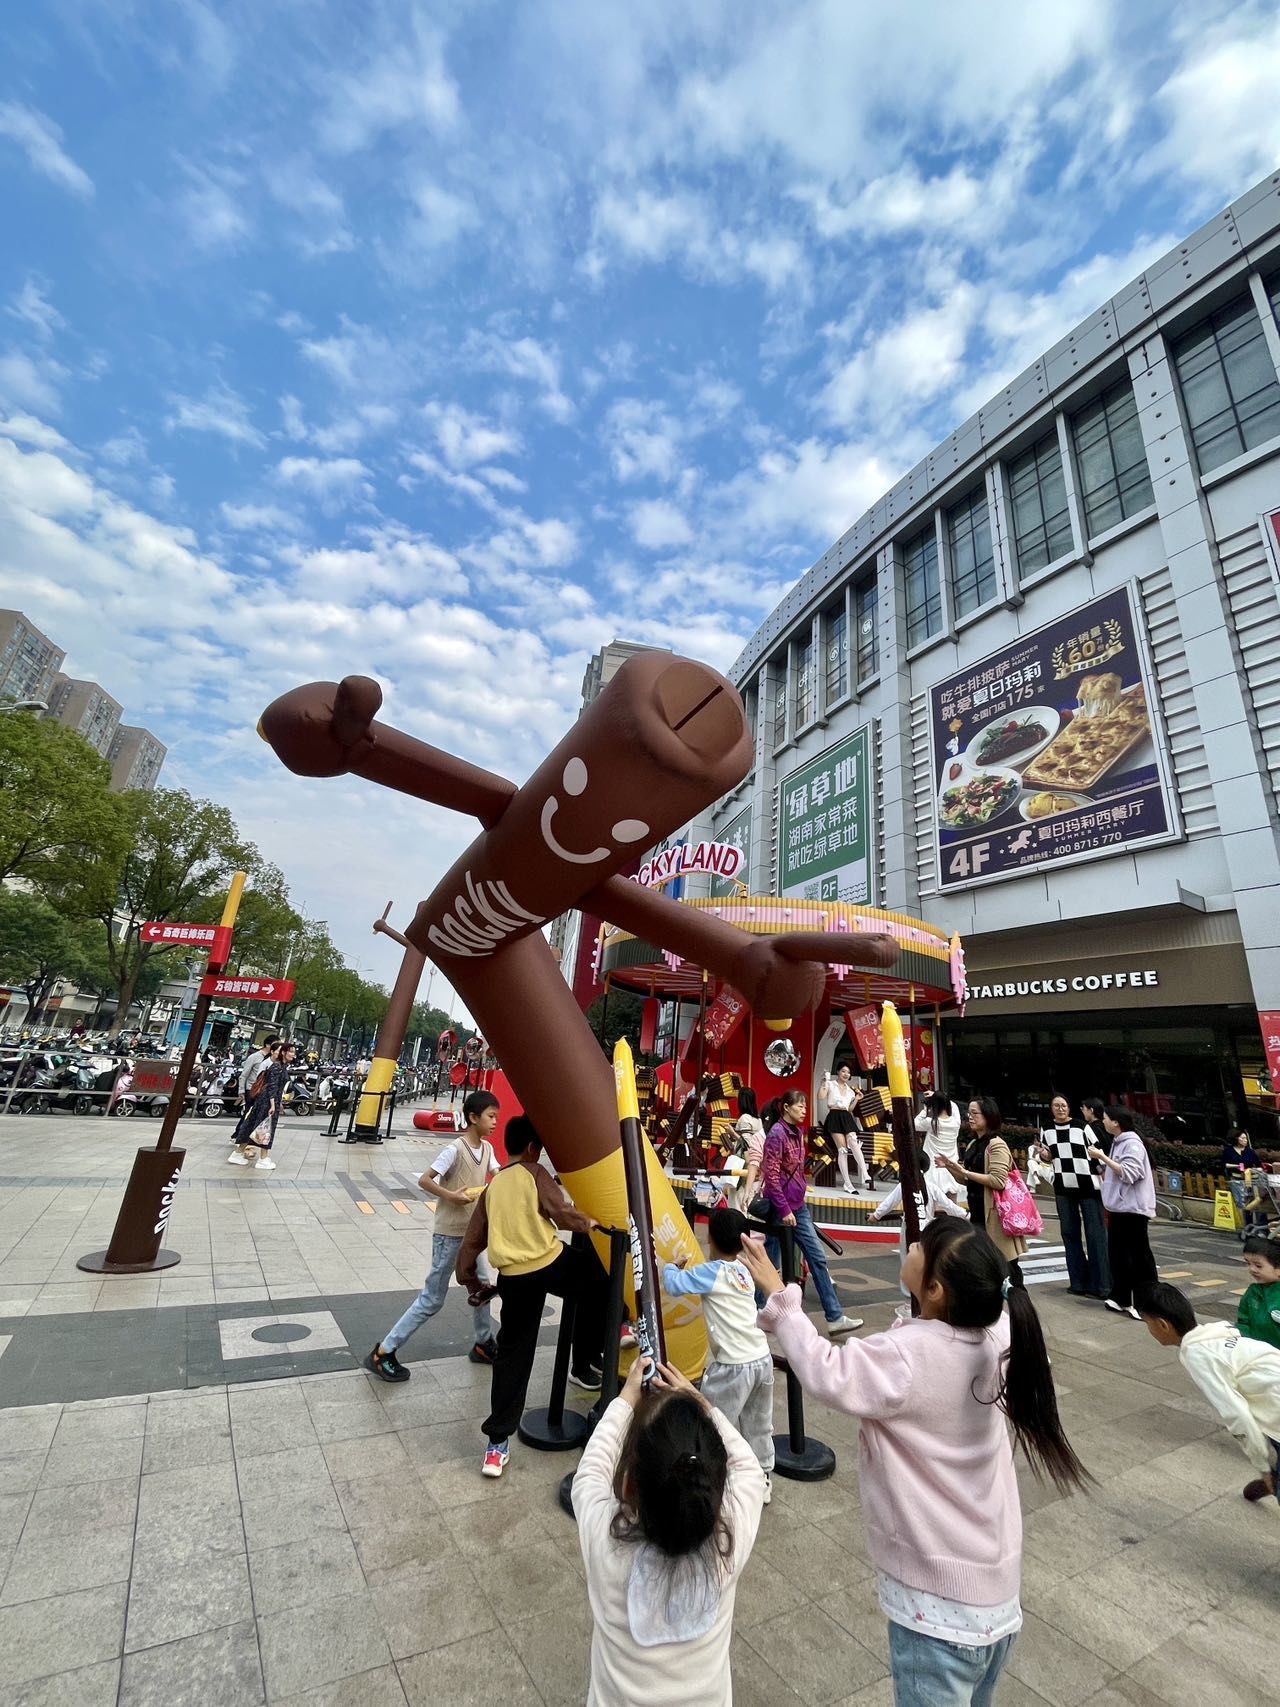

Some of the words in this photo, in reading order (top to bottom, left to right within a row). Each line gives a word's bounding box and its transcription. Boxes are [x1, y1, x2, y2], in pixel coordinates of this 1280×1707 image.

[1011, 644, 1039, 662] SUMMER
[1012, 655, 1030, 667] MARY
[1069, 641, 1095, 664] 60
[940, 660, 1011, 705] 吃牛排披萨
[941, 661, 1042, 721] 就爱夏日玛莉
[787, 754, 857, 822] 绿草地
[788, 796, 858, 849] 湖南家常菜
[1037, 799, 1145, 841] 夏日玛莉西餐厅
[1054, 829, 1092, 843] SUMMER
[1099, 820, 1126, 832] MARY
[681, 843, 739, 877] LAND
[788, 822, 859, 873] 就吃绿草地
[949, 841, 991, 878] 4F
[1053, 844, 1072, 856] 400
[1074, 837, 1099, 850] 8715
[1101, 831, 1122, 844] 770
[822, 880, 837, 900] 2F
[1071, 970, 1159, 991] COFFEE
